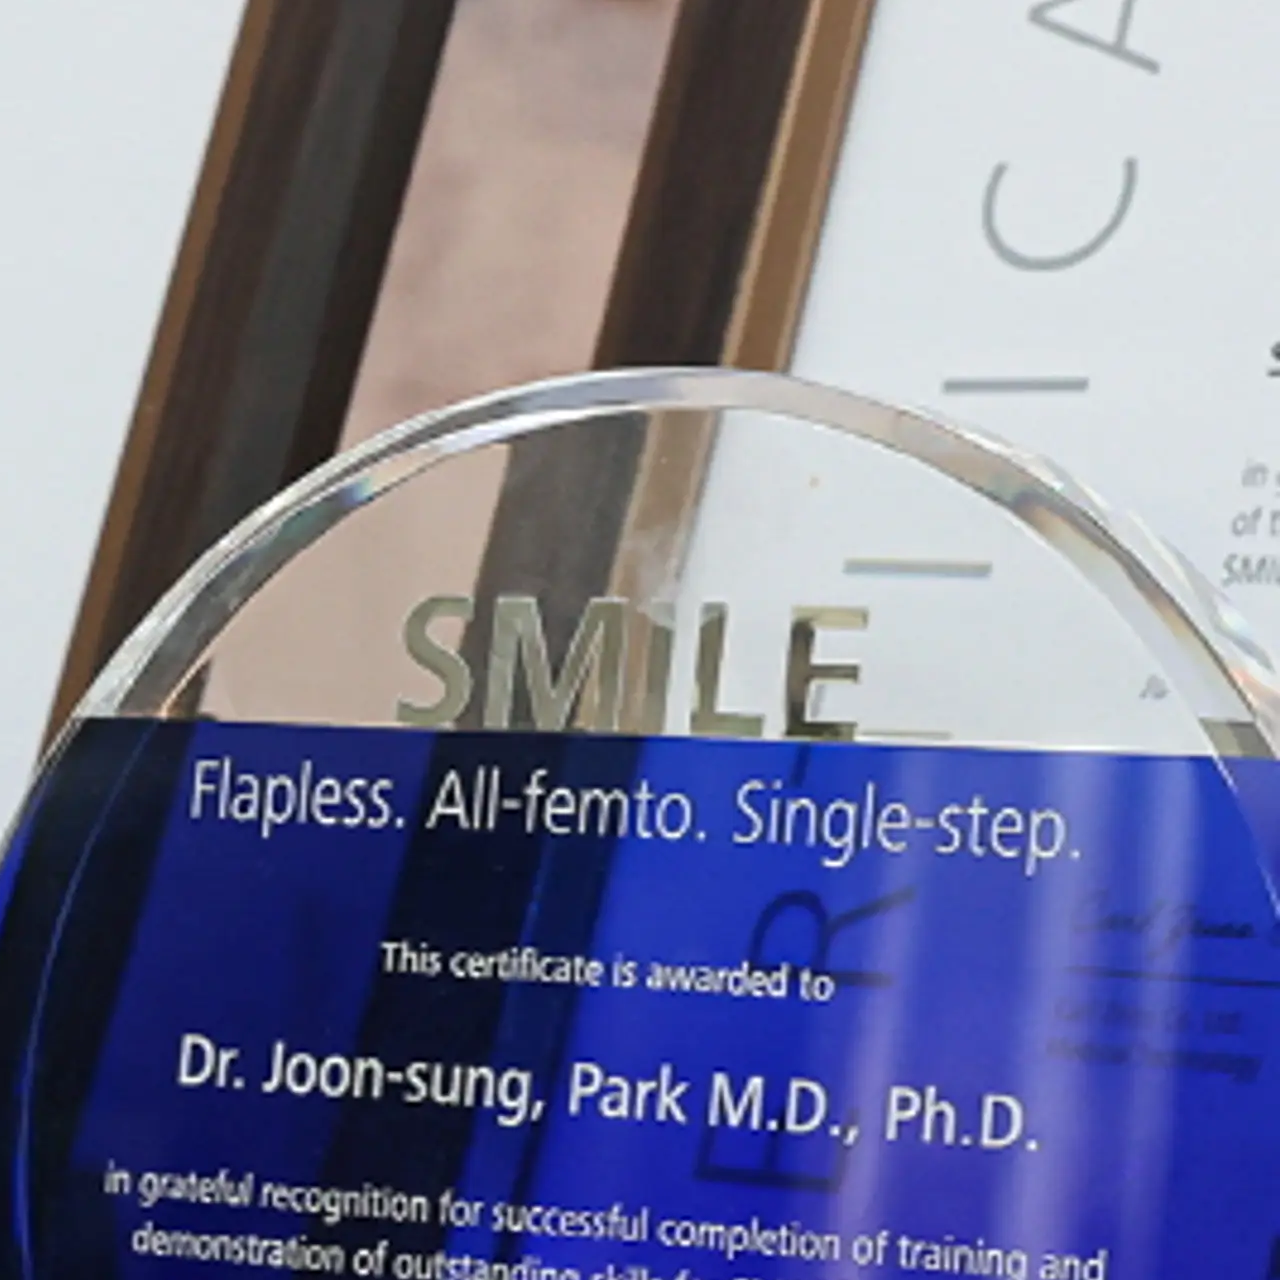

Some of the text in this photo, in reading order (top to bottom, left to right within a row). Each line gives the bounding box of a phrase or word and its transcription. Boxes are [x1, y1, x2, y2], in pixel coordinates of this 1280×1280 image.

[396, 594, 870, 742] SMILE
[190, 757, 1082, 876] Flapless. All-femto. Single-step.
[380, 940, 835, 1003] This certificate is awarded to
[177, 1032, 1040, 1153] Dr. Joon-sung, Park M.D., Ph.D.
[103, 1160, 132, 1195] in
[137, 1167, 255, 1208] grateful
[260, 1179, 429, 1225] recognition
[438, 1188, 484, 1228] for
[491, 1202, 649, 1243] successful
[657, 1215, 841, 1261] completion
[850, 1229, 889, 1268] of
[131, 1222, 344, 1274] demonstration
[351, 1240, 387, 1278] of
